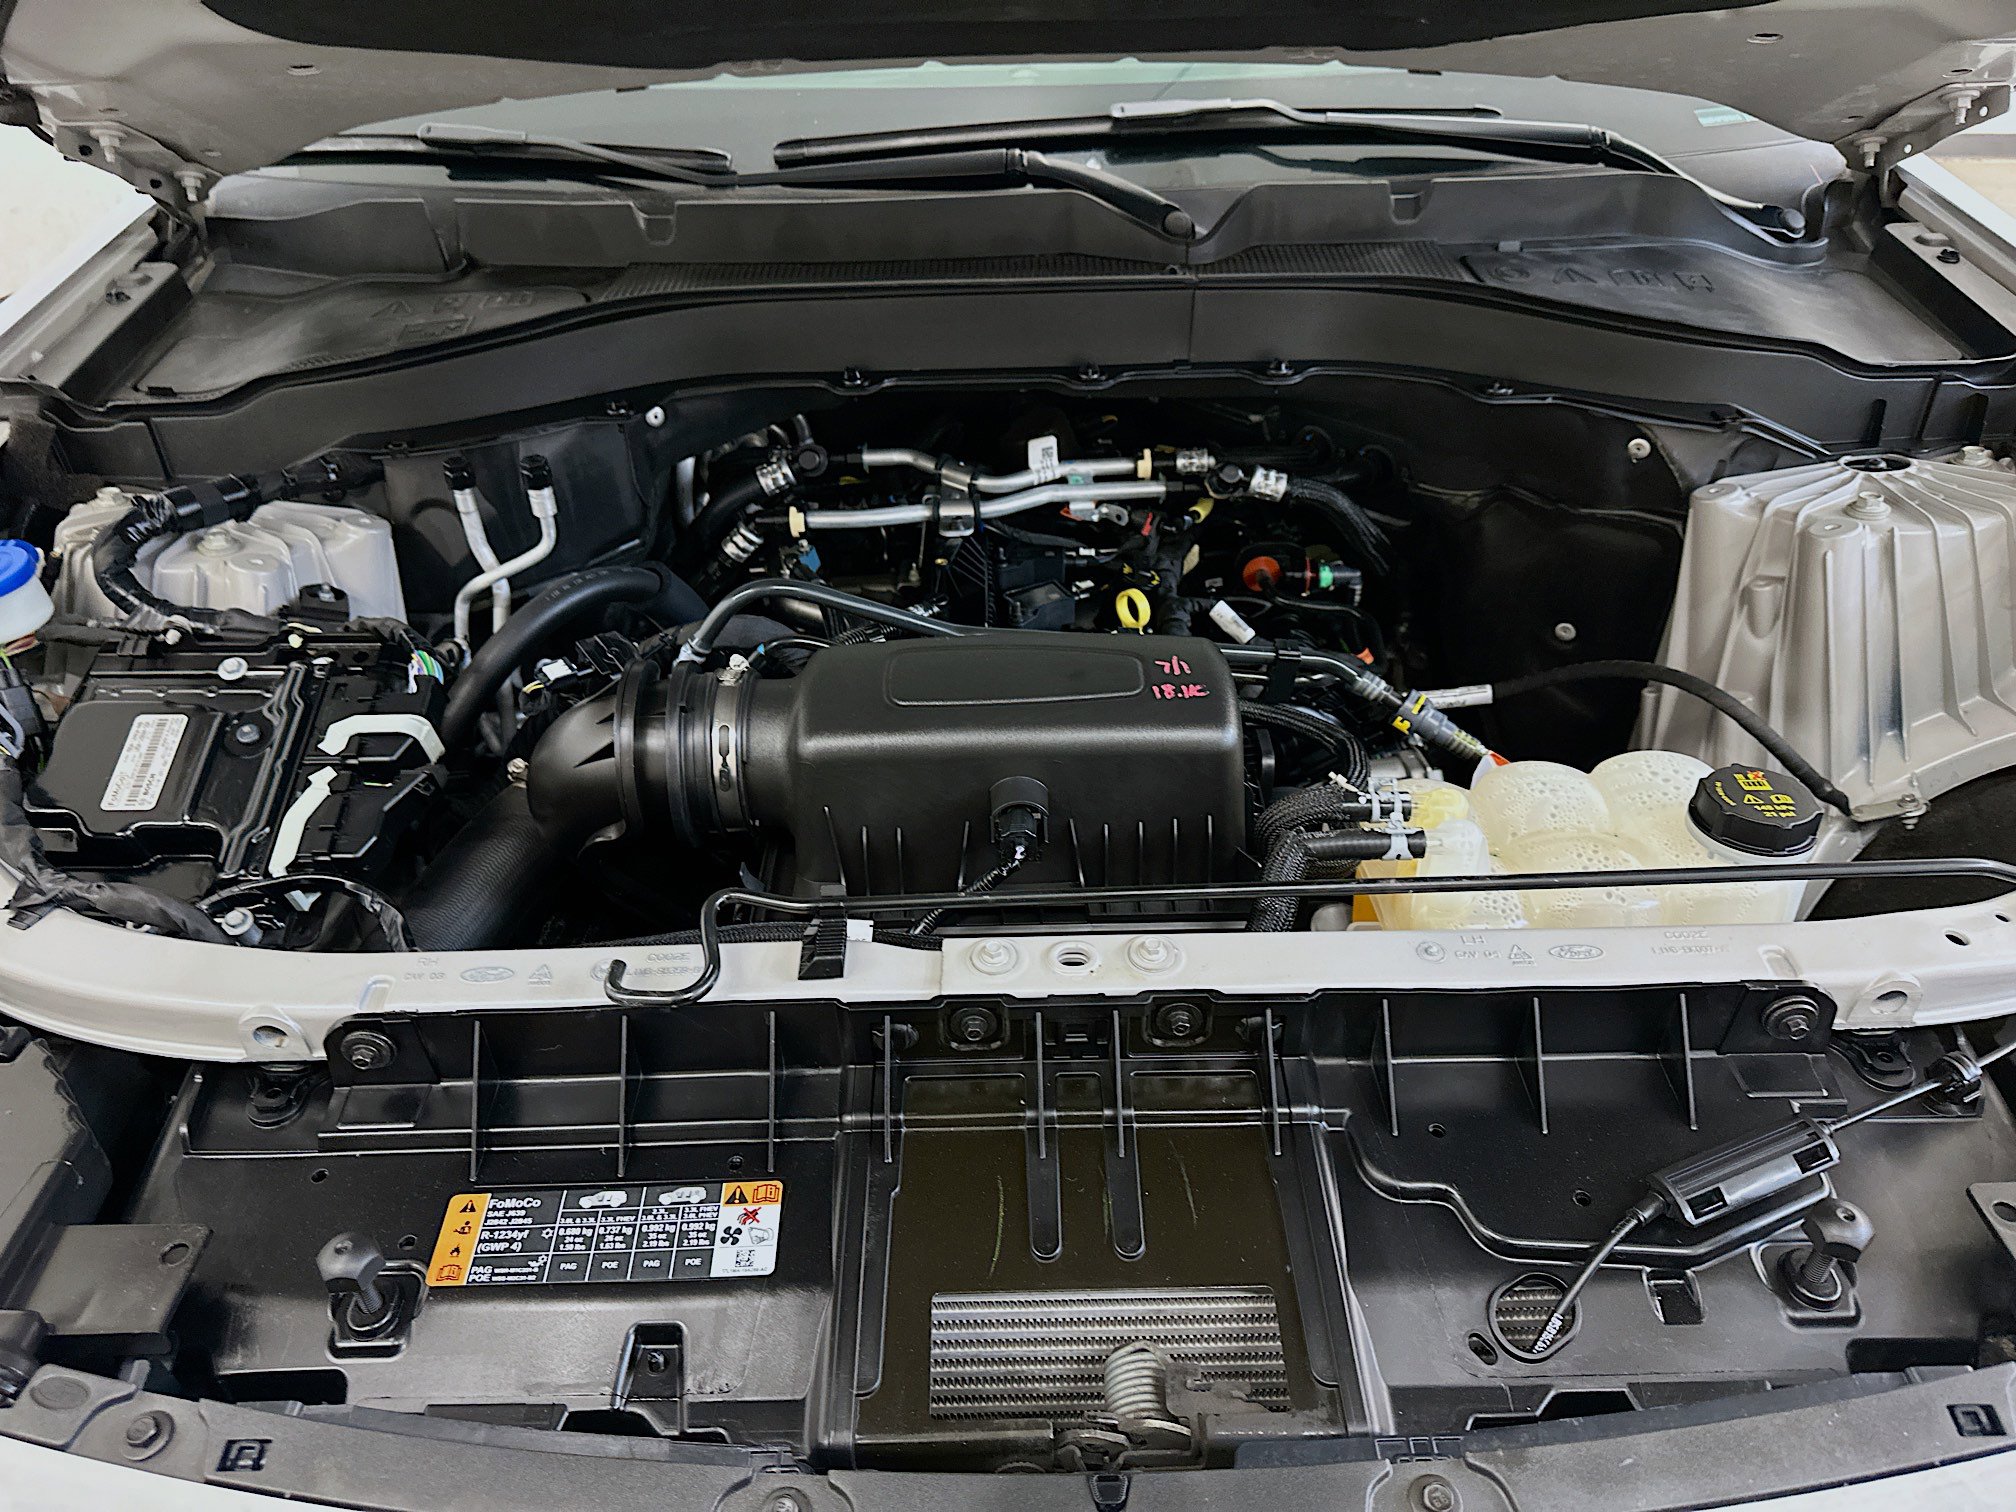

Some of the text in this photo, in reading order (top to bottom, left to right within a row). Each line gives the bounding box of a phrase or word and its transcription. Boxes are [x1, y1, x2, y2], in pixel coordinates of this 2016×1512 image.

[488, 1198, 541, 1209] FoMoCo
[486, 1210, 505, 1218] SAE
[599, 1226, 633, 1235] 0.737 kg
[665, 1223, 676, 1233] kg
[705, 1222, 716, 1232] kg
[481, 1229, 529, 1241] R-1234yf
[582, 1227, 593, 1236] kg
[477, 1241, 522, 1254] (GWP 4)
[560, 1262, 578, 1270] PAG
[601, 1261, 619, 1269] POE
[643, 1260, 660, 1268] PAG
[684, 1258, 702, 1266] POE
[470, 1266, 492, 1274] PAG
[468, 1274, 491, 1282] POE
